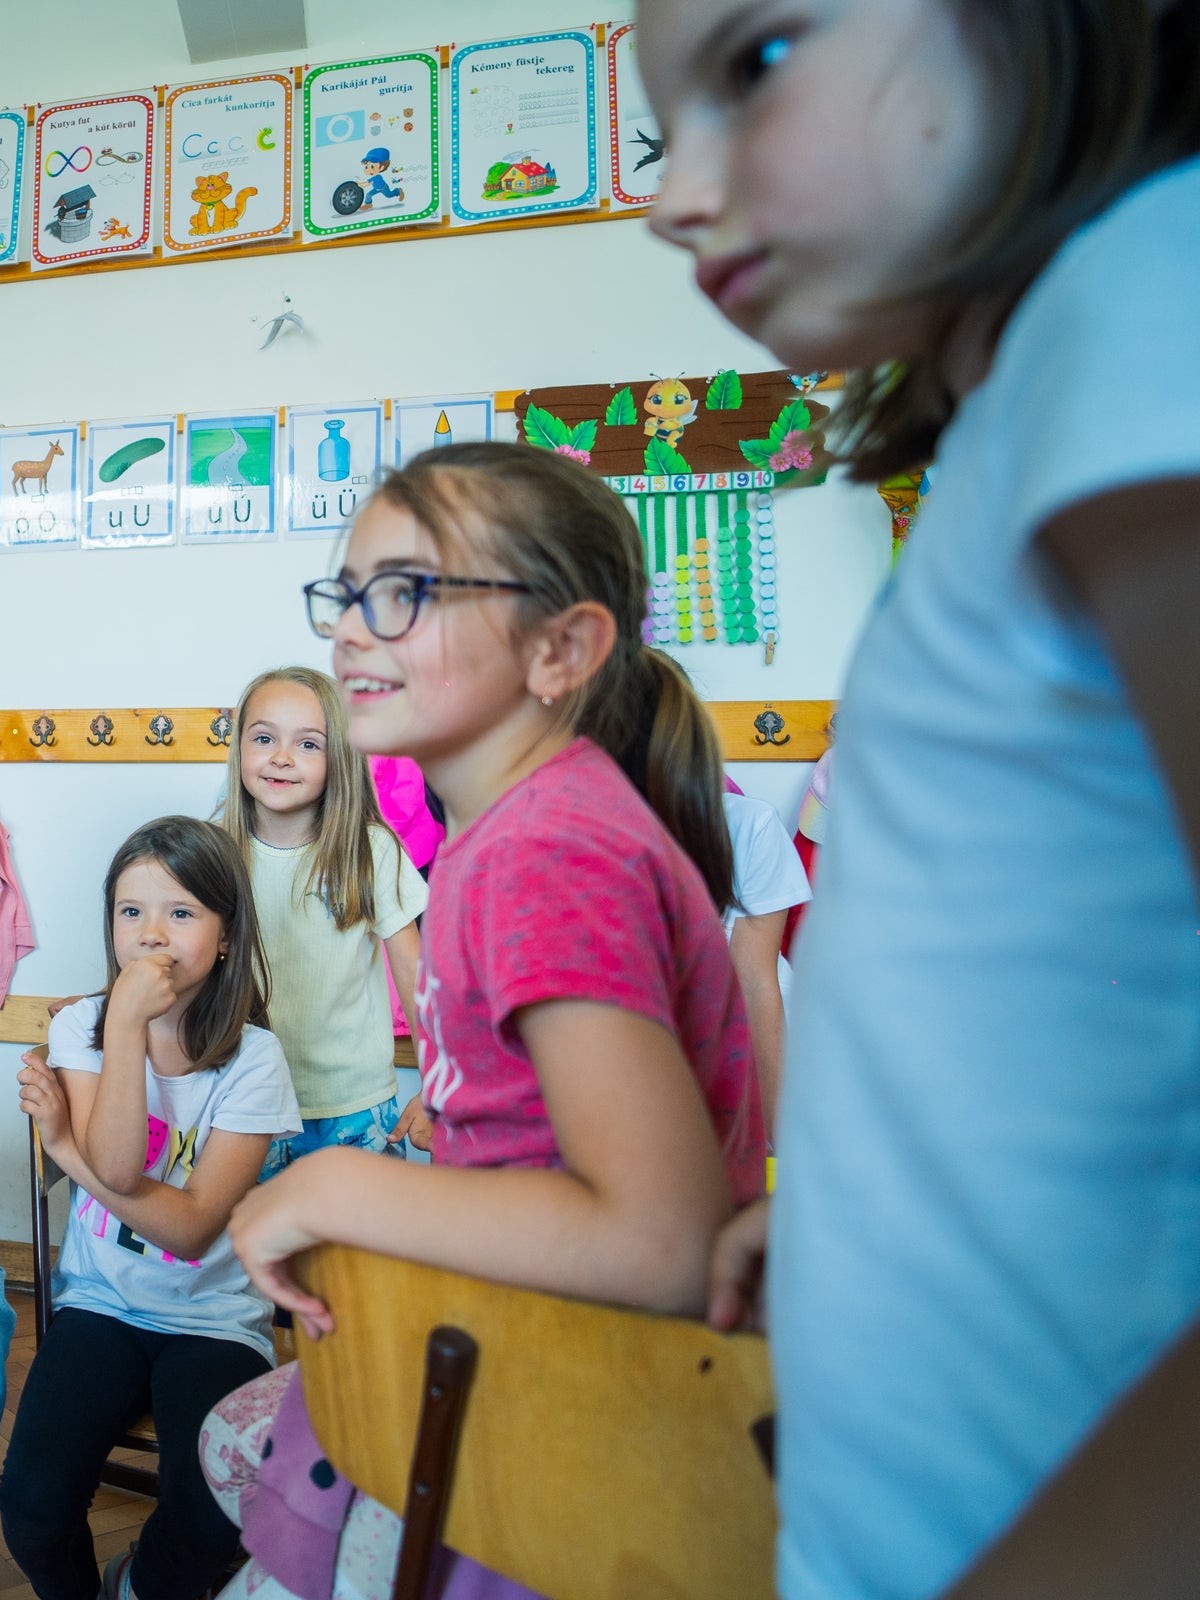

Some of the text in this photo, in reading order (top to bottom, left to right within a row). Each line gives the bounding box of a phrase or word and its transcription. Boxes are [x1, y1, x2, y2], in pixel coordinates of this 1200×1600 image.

[471, 56, 545, 73] Kémeny füstje
[536, 65, 575, 75] tekereg
[321, 75, 387, 92] Karikáját Pál
[379, 84, 413, 96] gurítja
[181, 94, 232, 109] Cica farkát
[225, 100, 275, 112] kunkorítja
[50, 117, 90, 129] Kutya fut
[95, 124, 110, 132] kút
[112, 120, 136, 130] körül
[613, 470, 772, 493] 3 4 5 6 7 8 9 10
